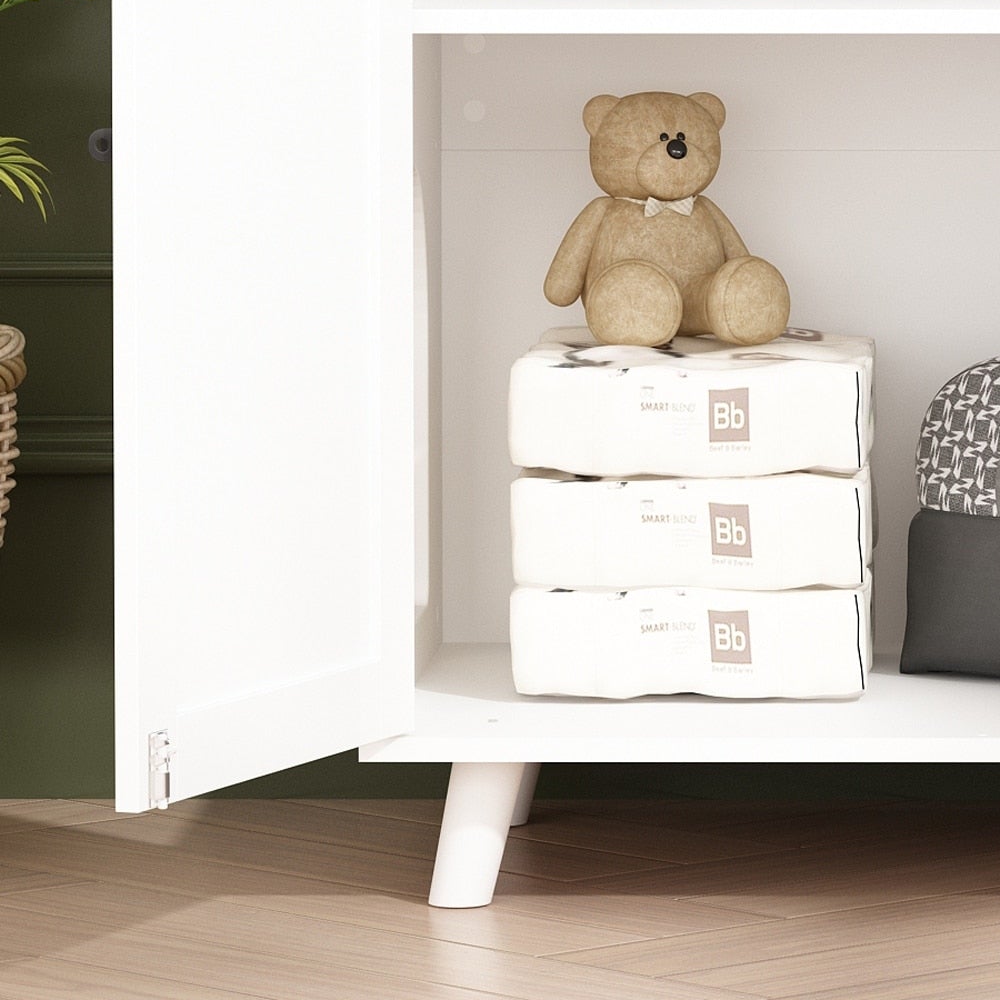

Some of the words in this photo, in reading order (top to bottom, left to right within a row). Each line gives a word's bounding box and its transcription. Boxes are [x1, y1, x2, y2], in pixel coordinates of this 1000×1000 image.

[640, 402, 669, 412] SMART
[714, 401, 745, 430] Bb
[641, 514, 670, 524] SMART
[715, 516, 747, 546] Bb
[640, 622, 669, 634] SMART
[714, 623, 746, 652] Bb
